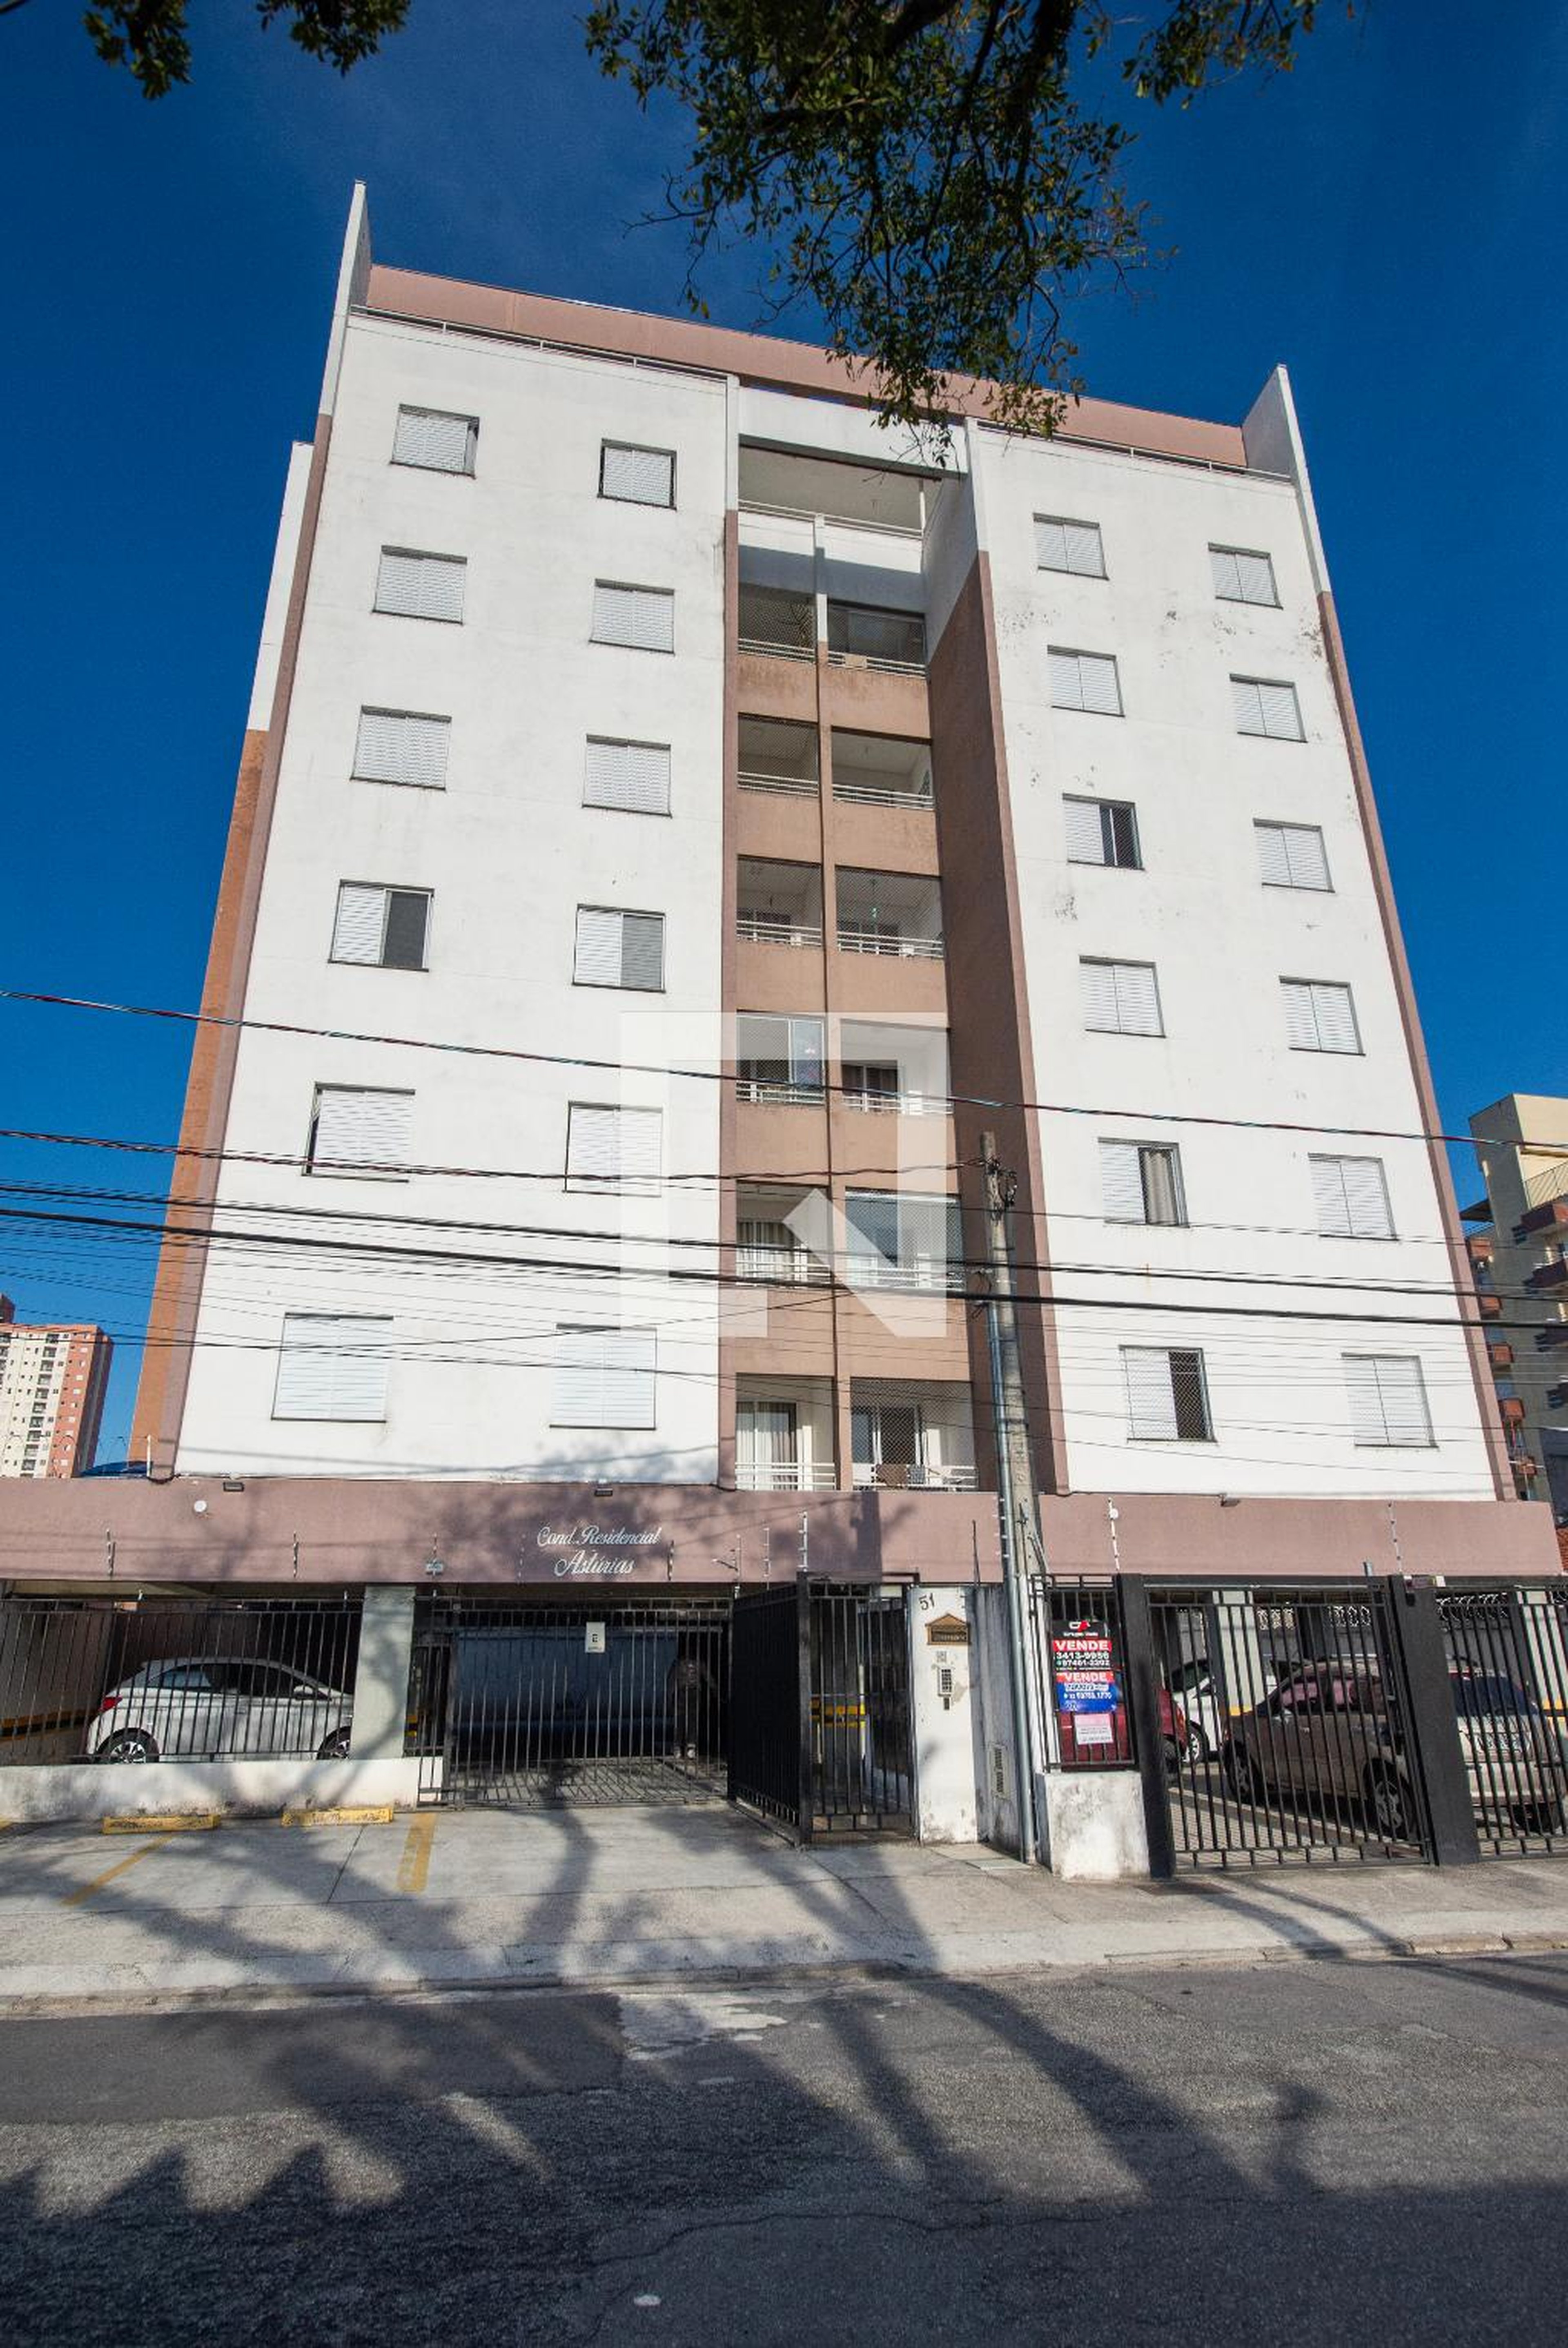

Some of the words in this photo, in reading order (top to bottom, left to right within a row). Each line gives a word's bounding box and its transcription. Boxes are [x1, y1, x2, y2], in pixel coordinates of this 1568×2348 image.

[580, 1525, 662, 1545] Residencial
[919, 1593, 935, 1610] 51
[1055, 1641, 1109, 1650] VENDE
[1064, 1672, 1107, 1681] VENDE
